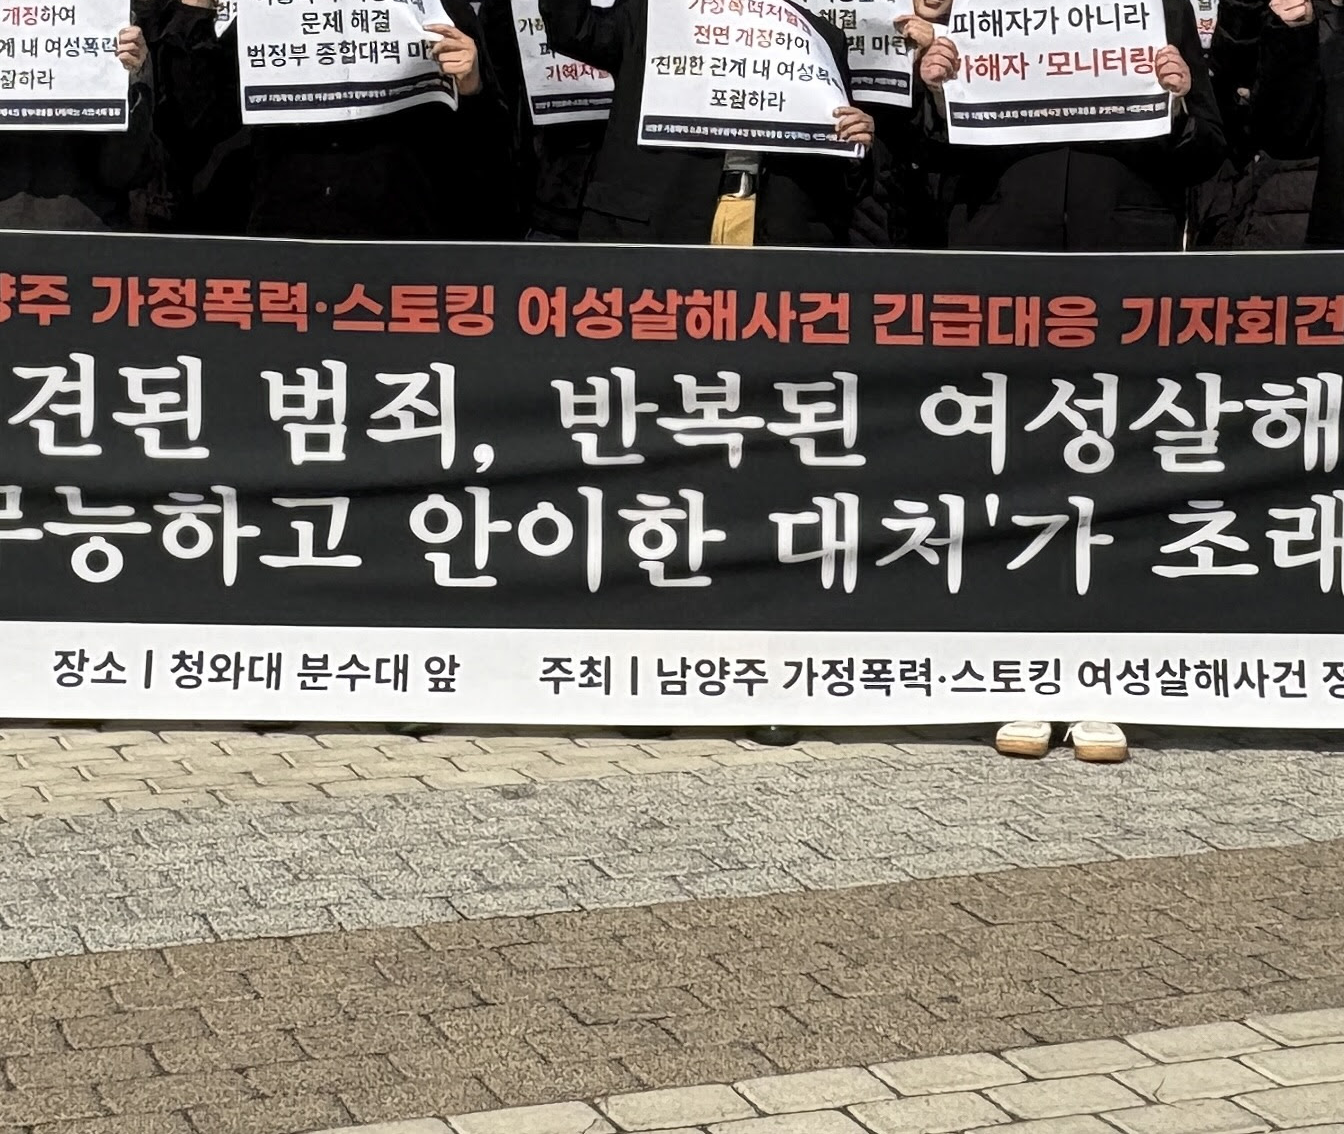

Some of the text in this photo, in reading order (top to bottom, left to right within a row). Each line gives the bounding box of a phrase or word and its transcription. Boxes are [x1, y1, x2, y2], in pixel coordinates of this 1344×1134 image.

[300, 8, 392, 36] 문제 해결
[950, 1, 1151, 40] 피해자가 아니라
[21, 36, 38, 58] 내
[246, 42, 310, 68] 범정부
[315, 39, 402, 66] 종합대책
[708, 56, 747, 79] 관계
[752, 58, 770, 81] 내
[92, 276, 495, 337] 가정폭력·스토킹
[518, 286, 850, 345] 여성살해사건
[873, 293, 1099, 348] 긴급대응
[260, 359, 495, 474] 범죄,
[550, 366, 867, 469] 반복된
[408, 485, 727, 593] 안이한
[768, 491, 1115, 596] 대처'가
[53, 648, 127, 688] 장소
[170, 650, 282, 691] 청와대
[297, 653, 409, 693] 분수대
[424, 654, 461, 693] 앞
[539, 655, 611, 696] 주최
[657, 656, 769, 697] 남양주
[782, 657, 1061, 697] 가정폭력·스토킹
[1077, 658, 1308, 698] 여성살해사건
